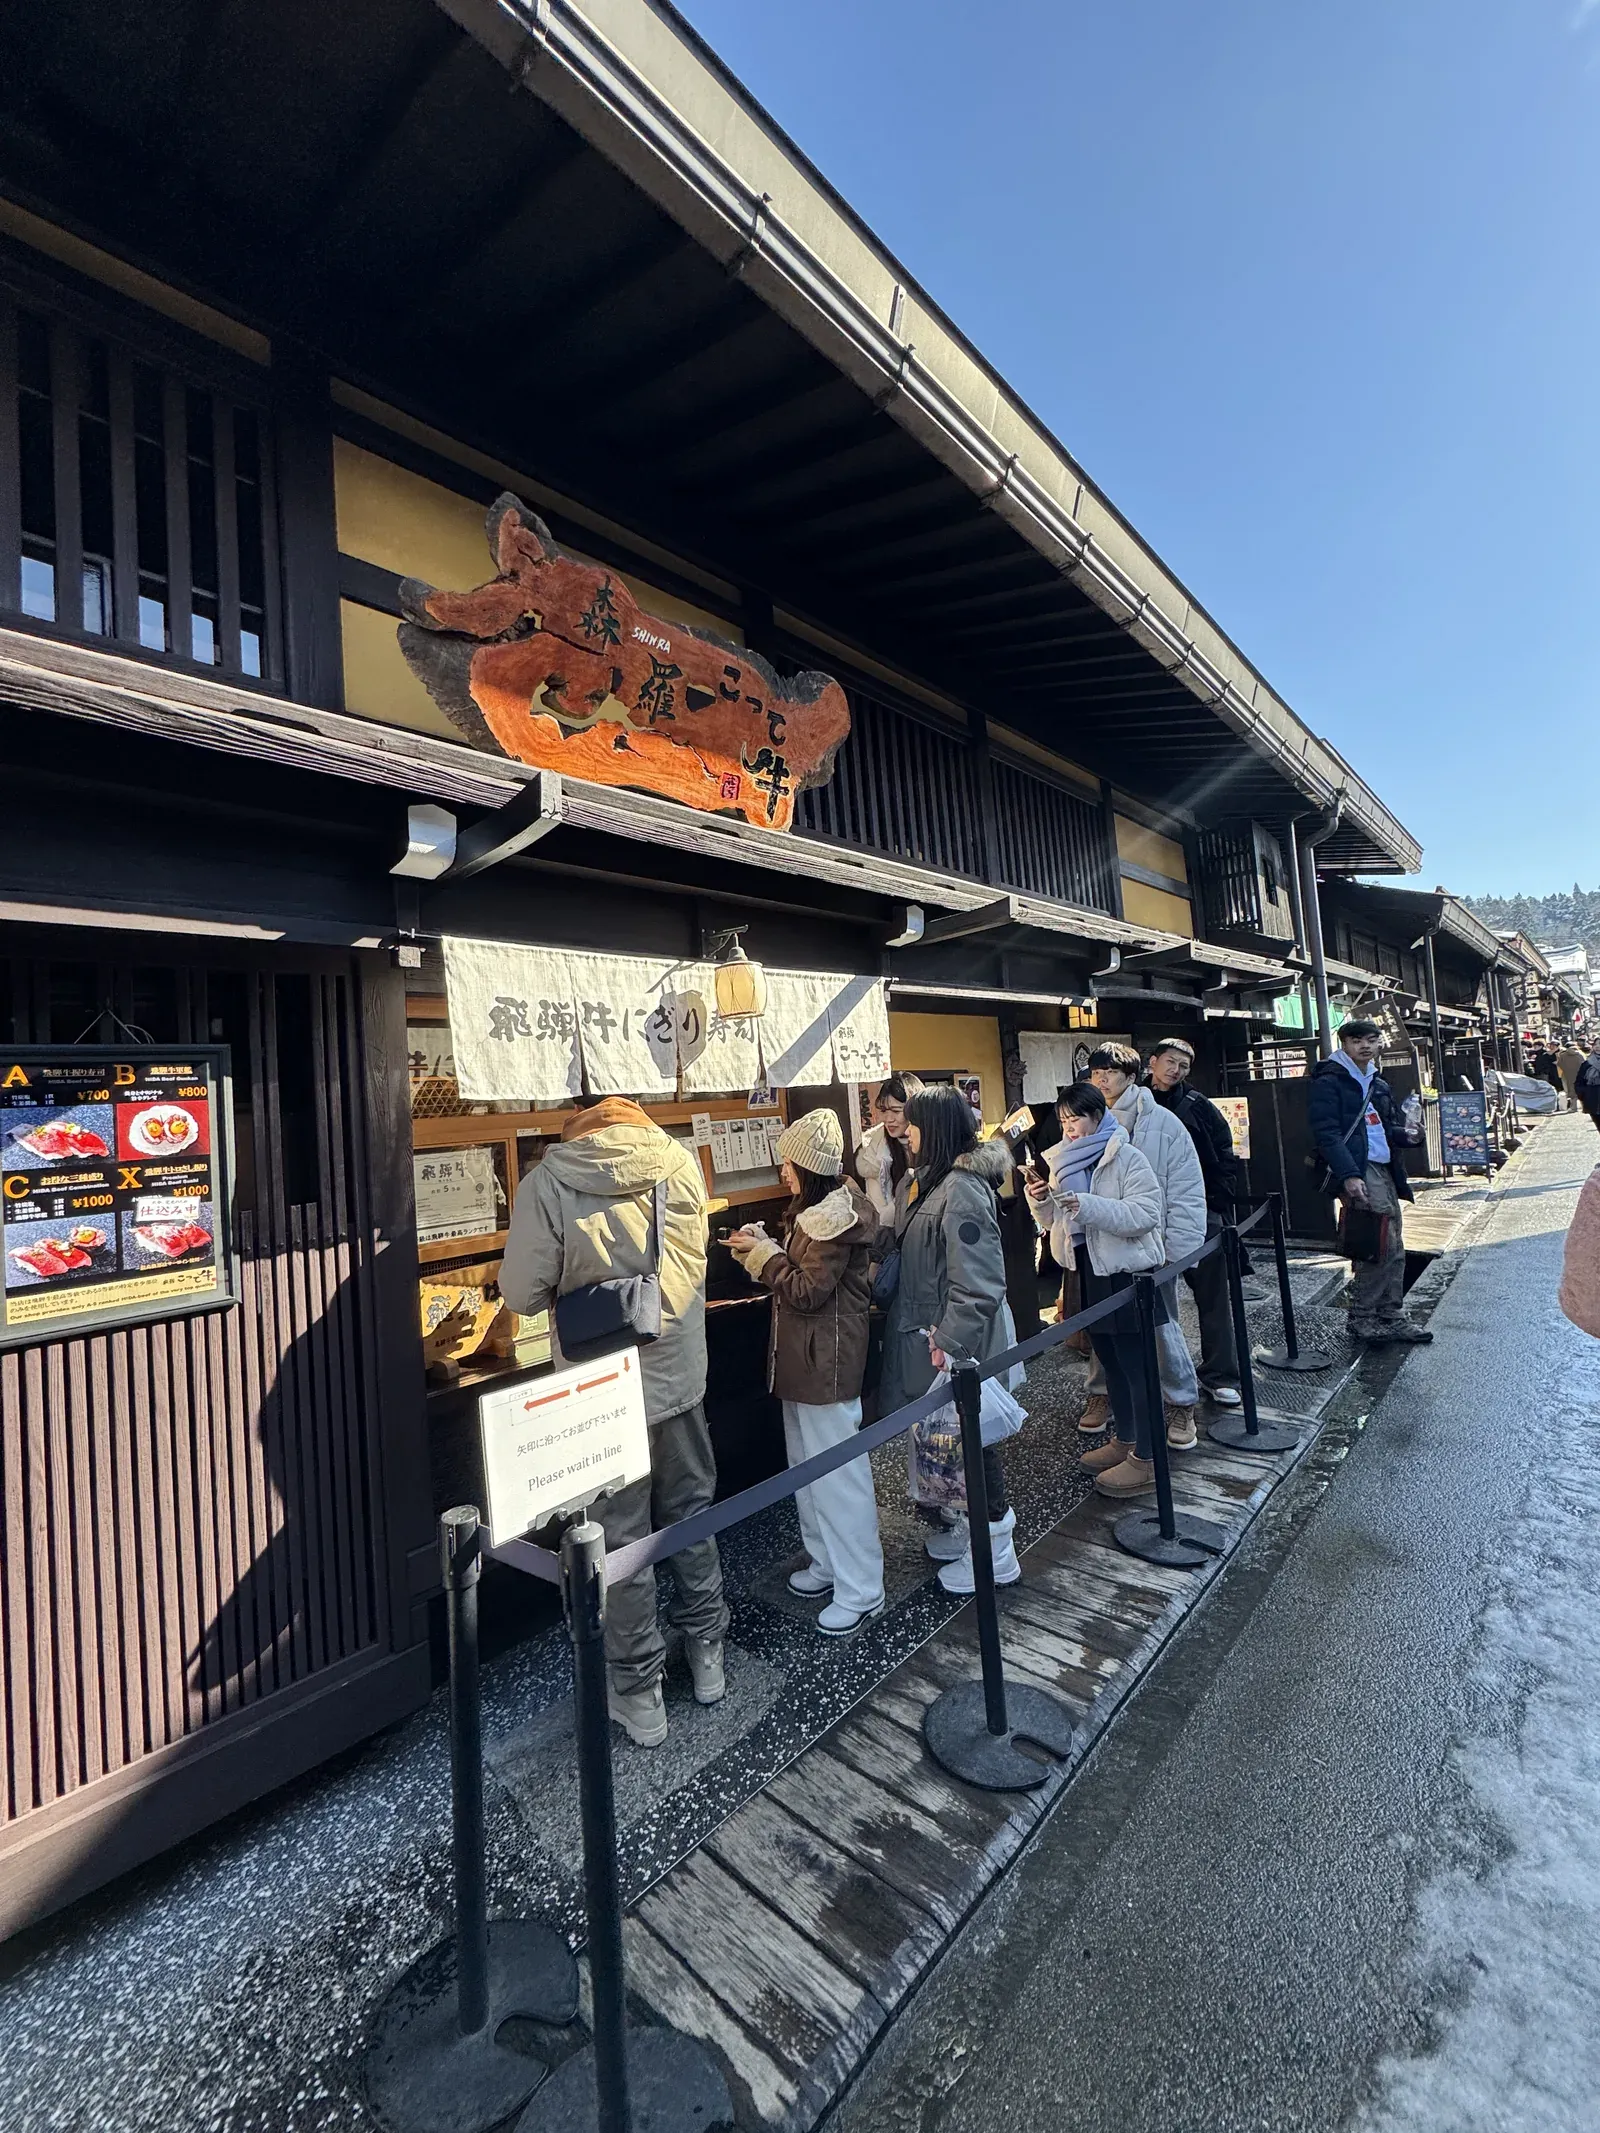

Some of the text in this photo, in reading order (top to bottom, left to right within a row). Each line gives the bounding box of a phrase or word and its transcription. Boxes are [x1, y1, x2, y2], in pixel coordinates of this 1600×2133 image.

[631, 626, 672, 654] SHINRA
[488, 996, 755, 1045] 飛騨牛にぎり寿司
[1, 1065, 33, 1087] A
[113, 1064, 136, 1085] B
[77, 1089, 110, 1101] ¥700
[178, 1086, 208, 1097] ¥800
[3, 1175, 31, 1199] C
[117, 1167, 143, 1190] X
[72, 1194, 113, 1208] ¥1000
[172, 1184, 209, 1198] ¥1000
[140, 1203, 197, 1217] 仕込み中
[417, 1225, 489, 1243] 級は飛騨牛最高ランクです
[516, 1405, 628, 1458] 矢印に沿ってお並び下さいませ
[528, 1443, 623, 1492] Please wait in line
